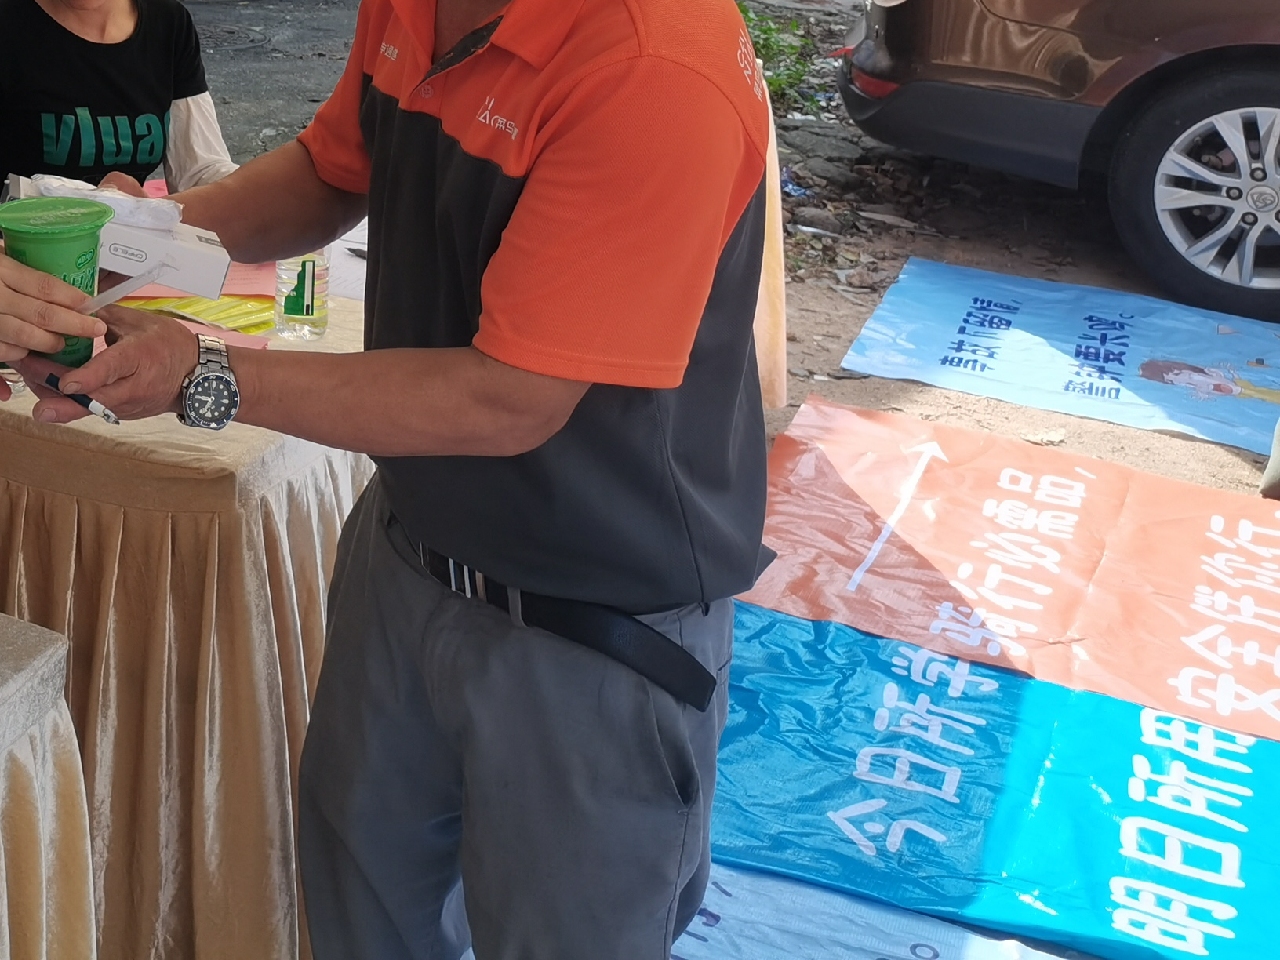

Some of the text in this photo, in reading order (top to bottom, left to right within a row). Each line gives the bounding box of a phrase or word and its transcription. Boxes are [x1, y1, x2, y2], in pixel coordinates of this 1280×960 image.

[41, 106, 171, 167] vlua
[928, 466, 1096, 657] 骑行必需品，
[827, 644, 999, 855] 今日所学
[1107, 706, 1257, 957] 明日所用
